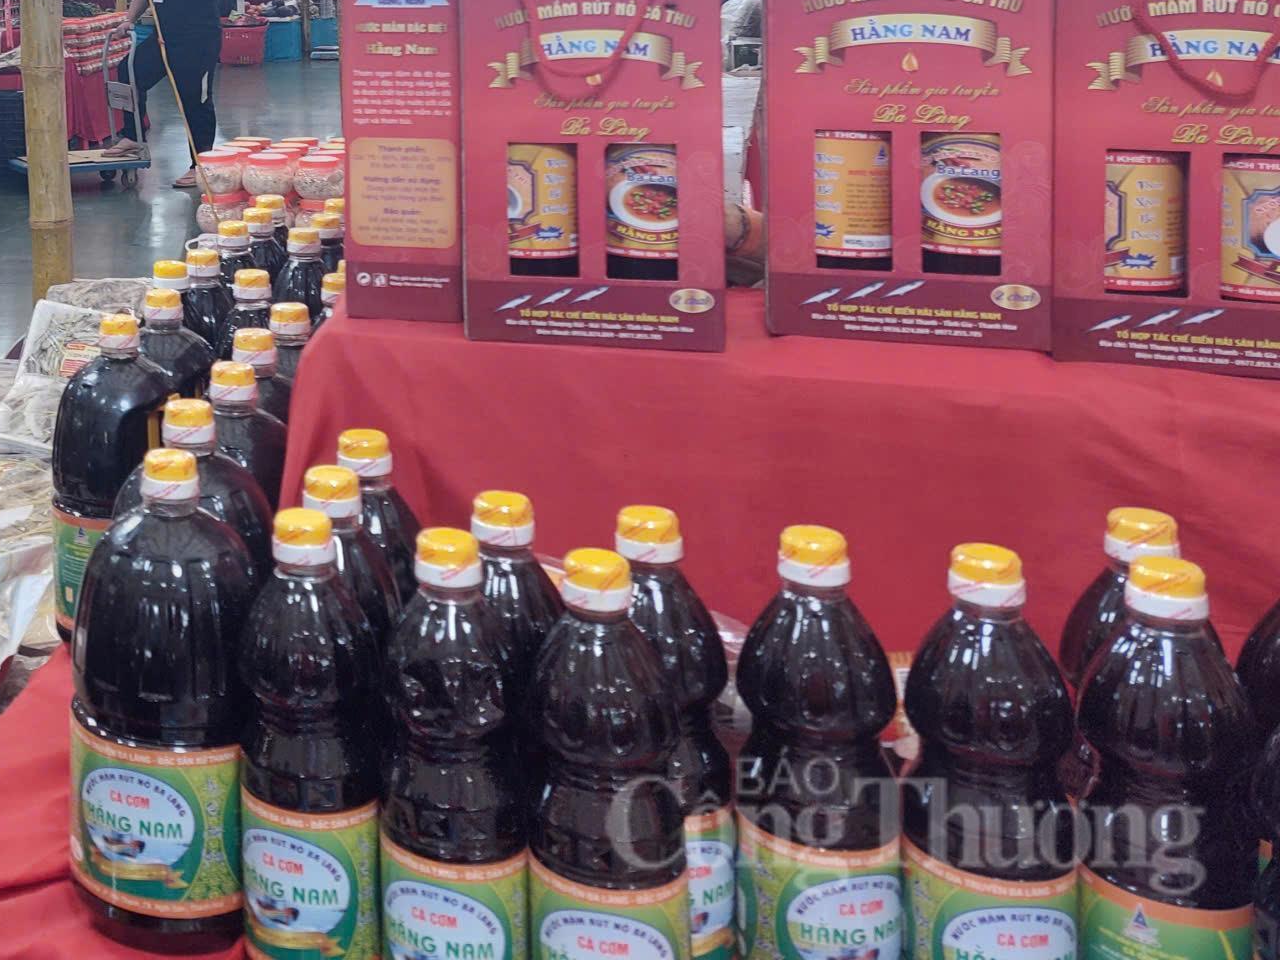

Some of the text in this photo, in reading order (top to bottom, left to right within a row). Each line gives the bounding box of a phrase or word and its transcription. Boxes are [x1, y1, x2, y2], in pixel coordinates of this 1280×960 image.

[582, 0, 611, 16] RÚT
[664, 9, 697, 29] THU
[1095, 5, 1133, 28] NƯỚ
[851, 19, 972, 42] HẰNG NAM
[560, 116, 651, 141] Ba Làng
[872, 103, 972, 131] Ba Làng
[1171, 123, 1209, 145] Ba
[139, 820, 183, 839] NAM
[293, 886, 339, 906] NAM
[800, 917, 867, 945] HẰNG
[446, 941, 495, 959] NAM
